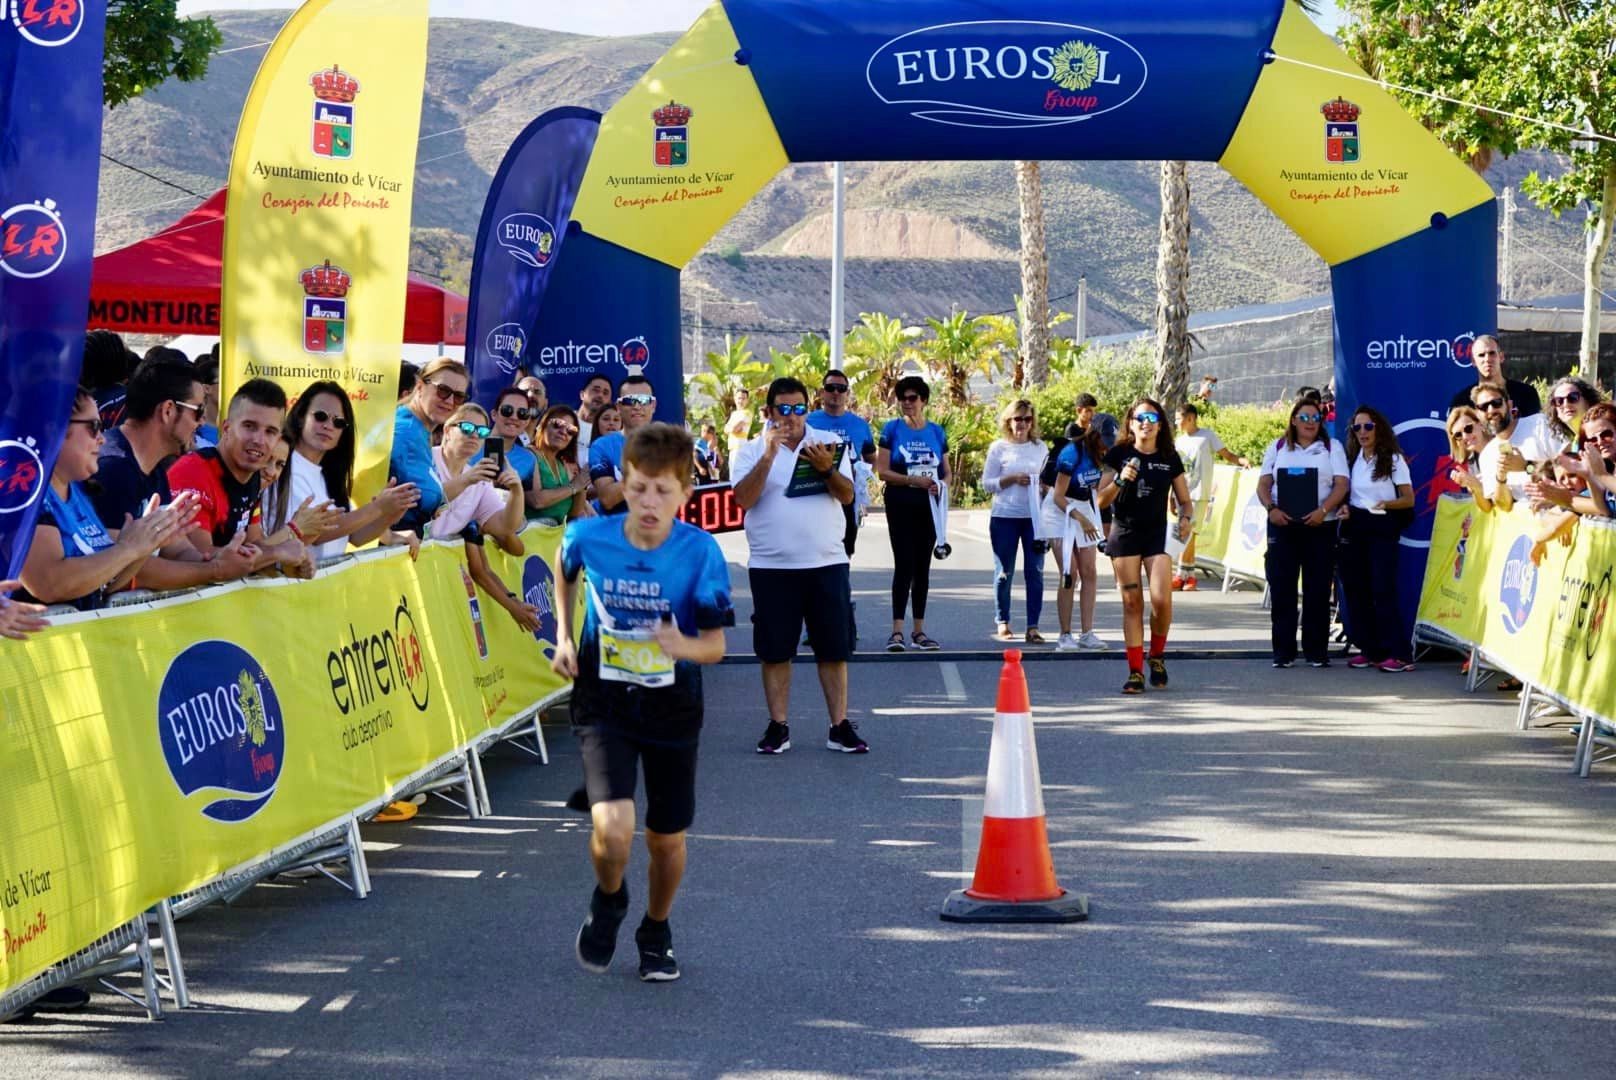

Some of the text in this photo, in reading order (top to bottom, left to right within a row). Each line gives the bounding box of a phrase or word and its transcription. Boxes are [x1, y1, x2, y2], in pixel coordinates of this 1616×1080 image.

[1043, 89, 1098, 112] Group
[252, 160, 403, 193] Ayuntamiento de Vícar
[606, 171, 735, 187] Ayuntamiento de Vícar
[1280, 169, 1408, 182] Ayuntamiento de Vícar
[262, 191, 390, 214] Corazón del Poniente
[614, 186, 724, 210] Corazón del Poniente
[1290, 184, 1400, 204] Corazón del Poniente
[3, 223, 60, 259] LR
[88, 300, 220, 325] MONTURE
[244, 361, 340, 380] Ayuntamiento
[351, 366, 385, 384] Vícar
[555, 365, 595, 375] deportivo
[1367, 361, 1427, 370] club deportivo
[342, 709, 393, 750] club deportivo
[5, 868, 51, 908] de Vícar
